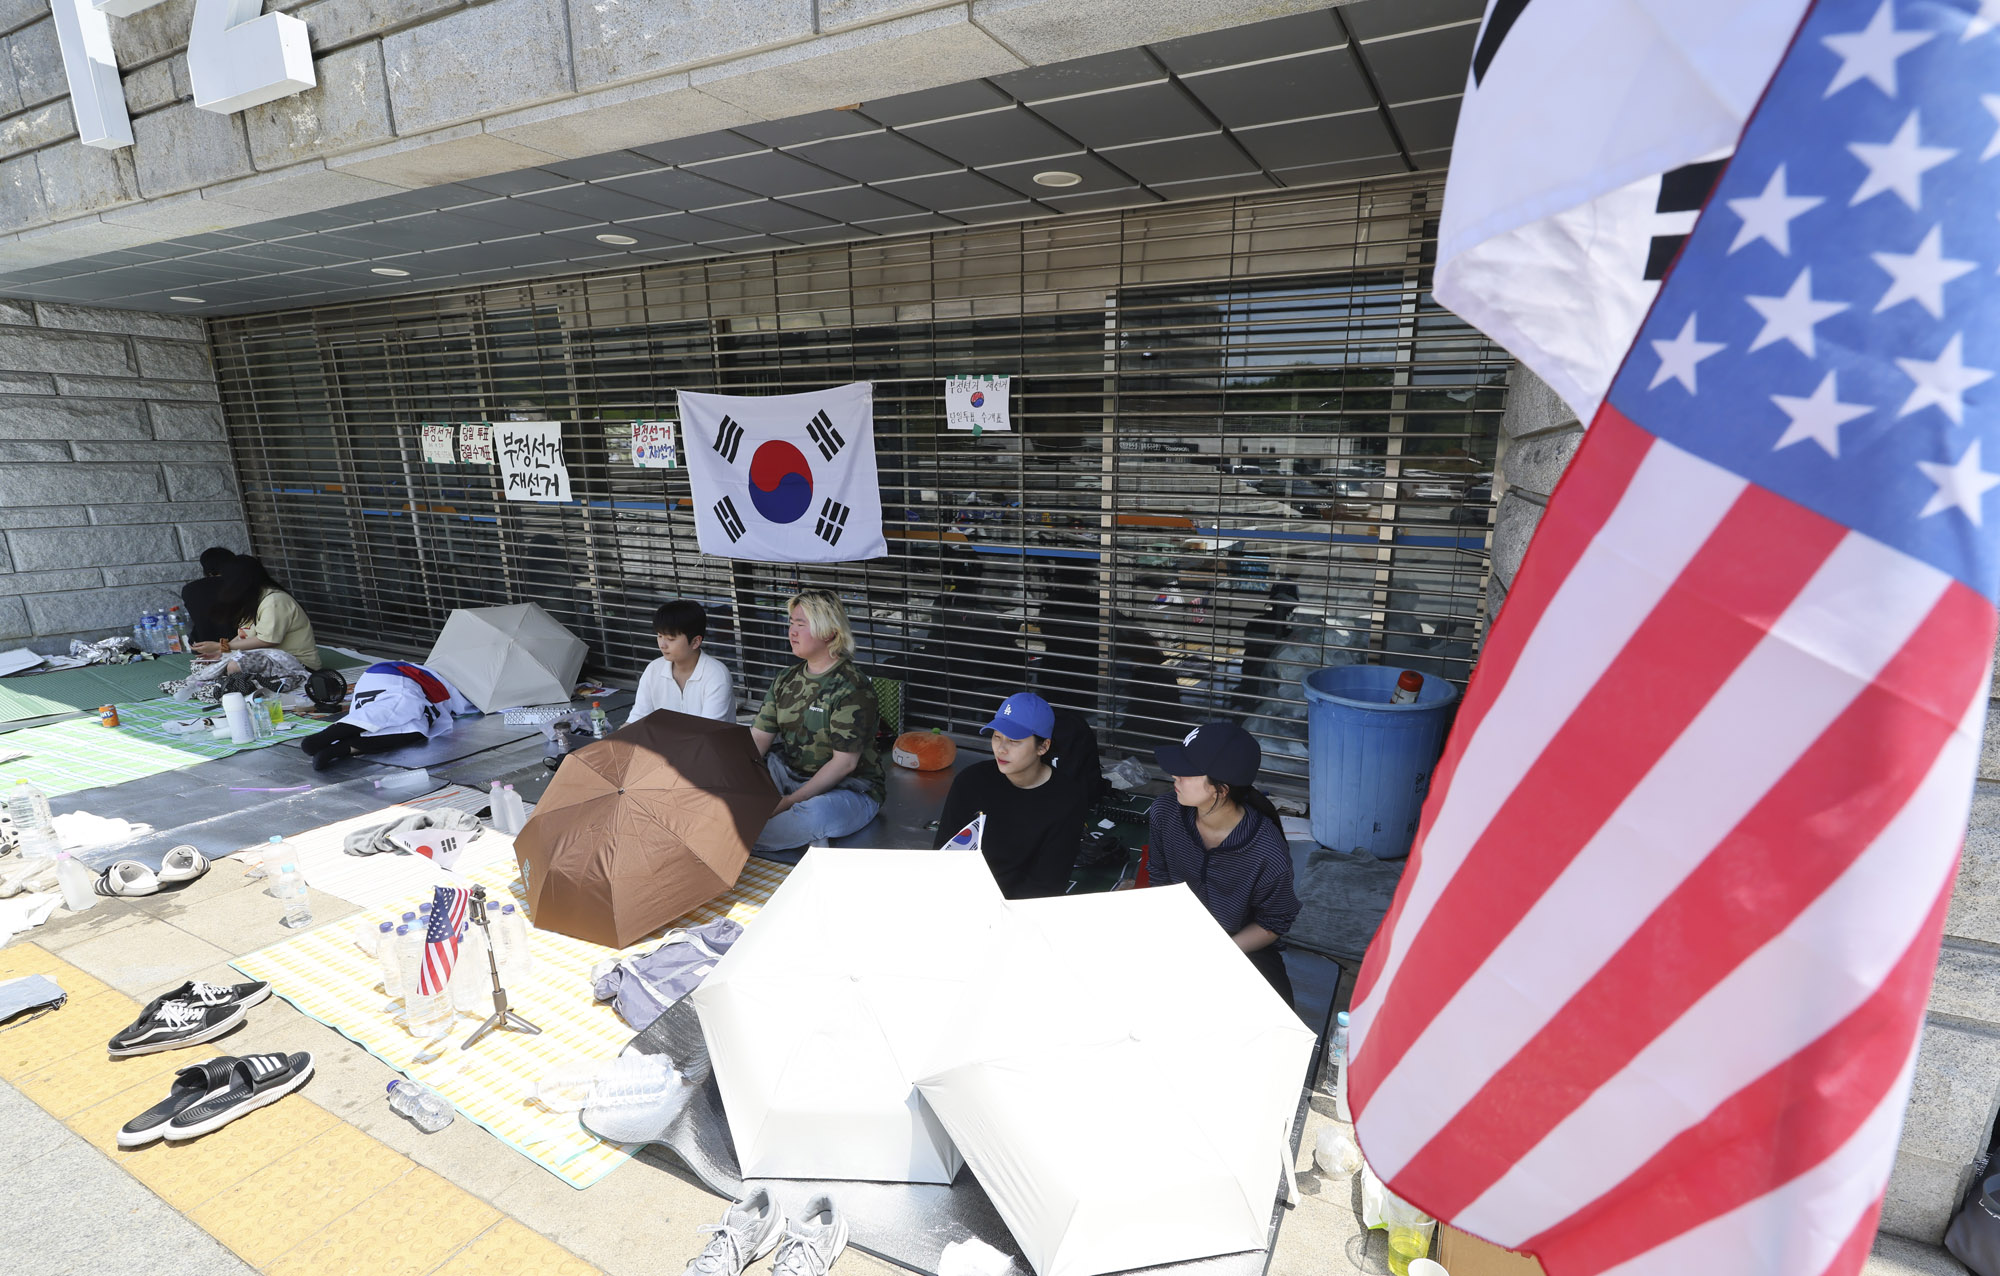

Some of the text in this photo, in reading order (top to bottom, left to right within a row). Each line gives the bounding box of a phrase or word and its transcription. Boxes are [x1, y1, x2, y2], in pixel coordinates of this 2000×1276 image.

[948, 380, 979, 394] 부정선거
[423, 426, 452, 442] 부정선거
[462, 427, 489, 441] 당일 투표
[633, 424, 671, 442] 부정선거
[503, 431, 564, 469] 부정선거
[508, 472, 559, 497] 재선거
